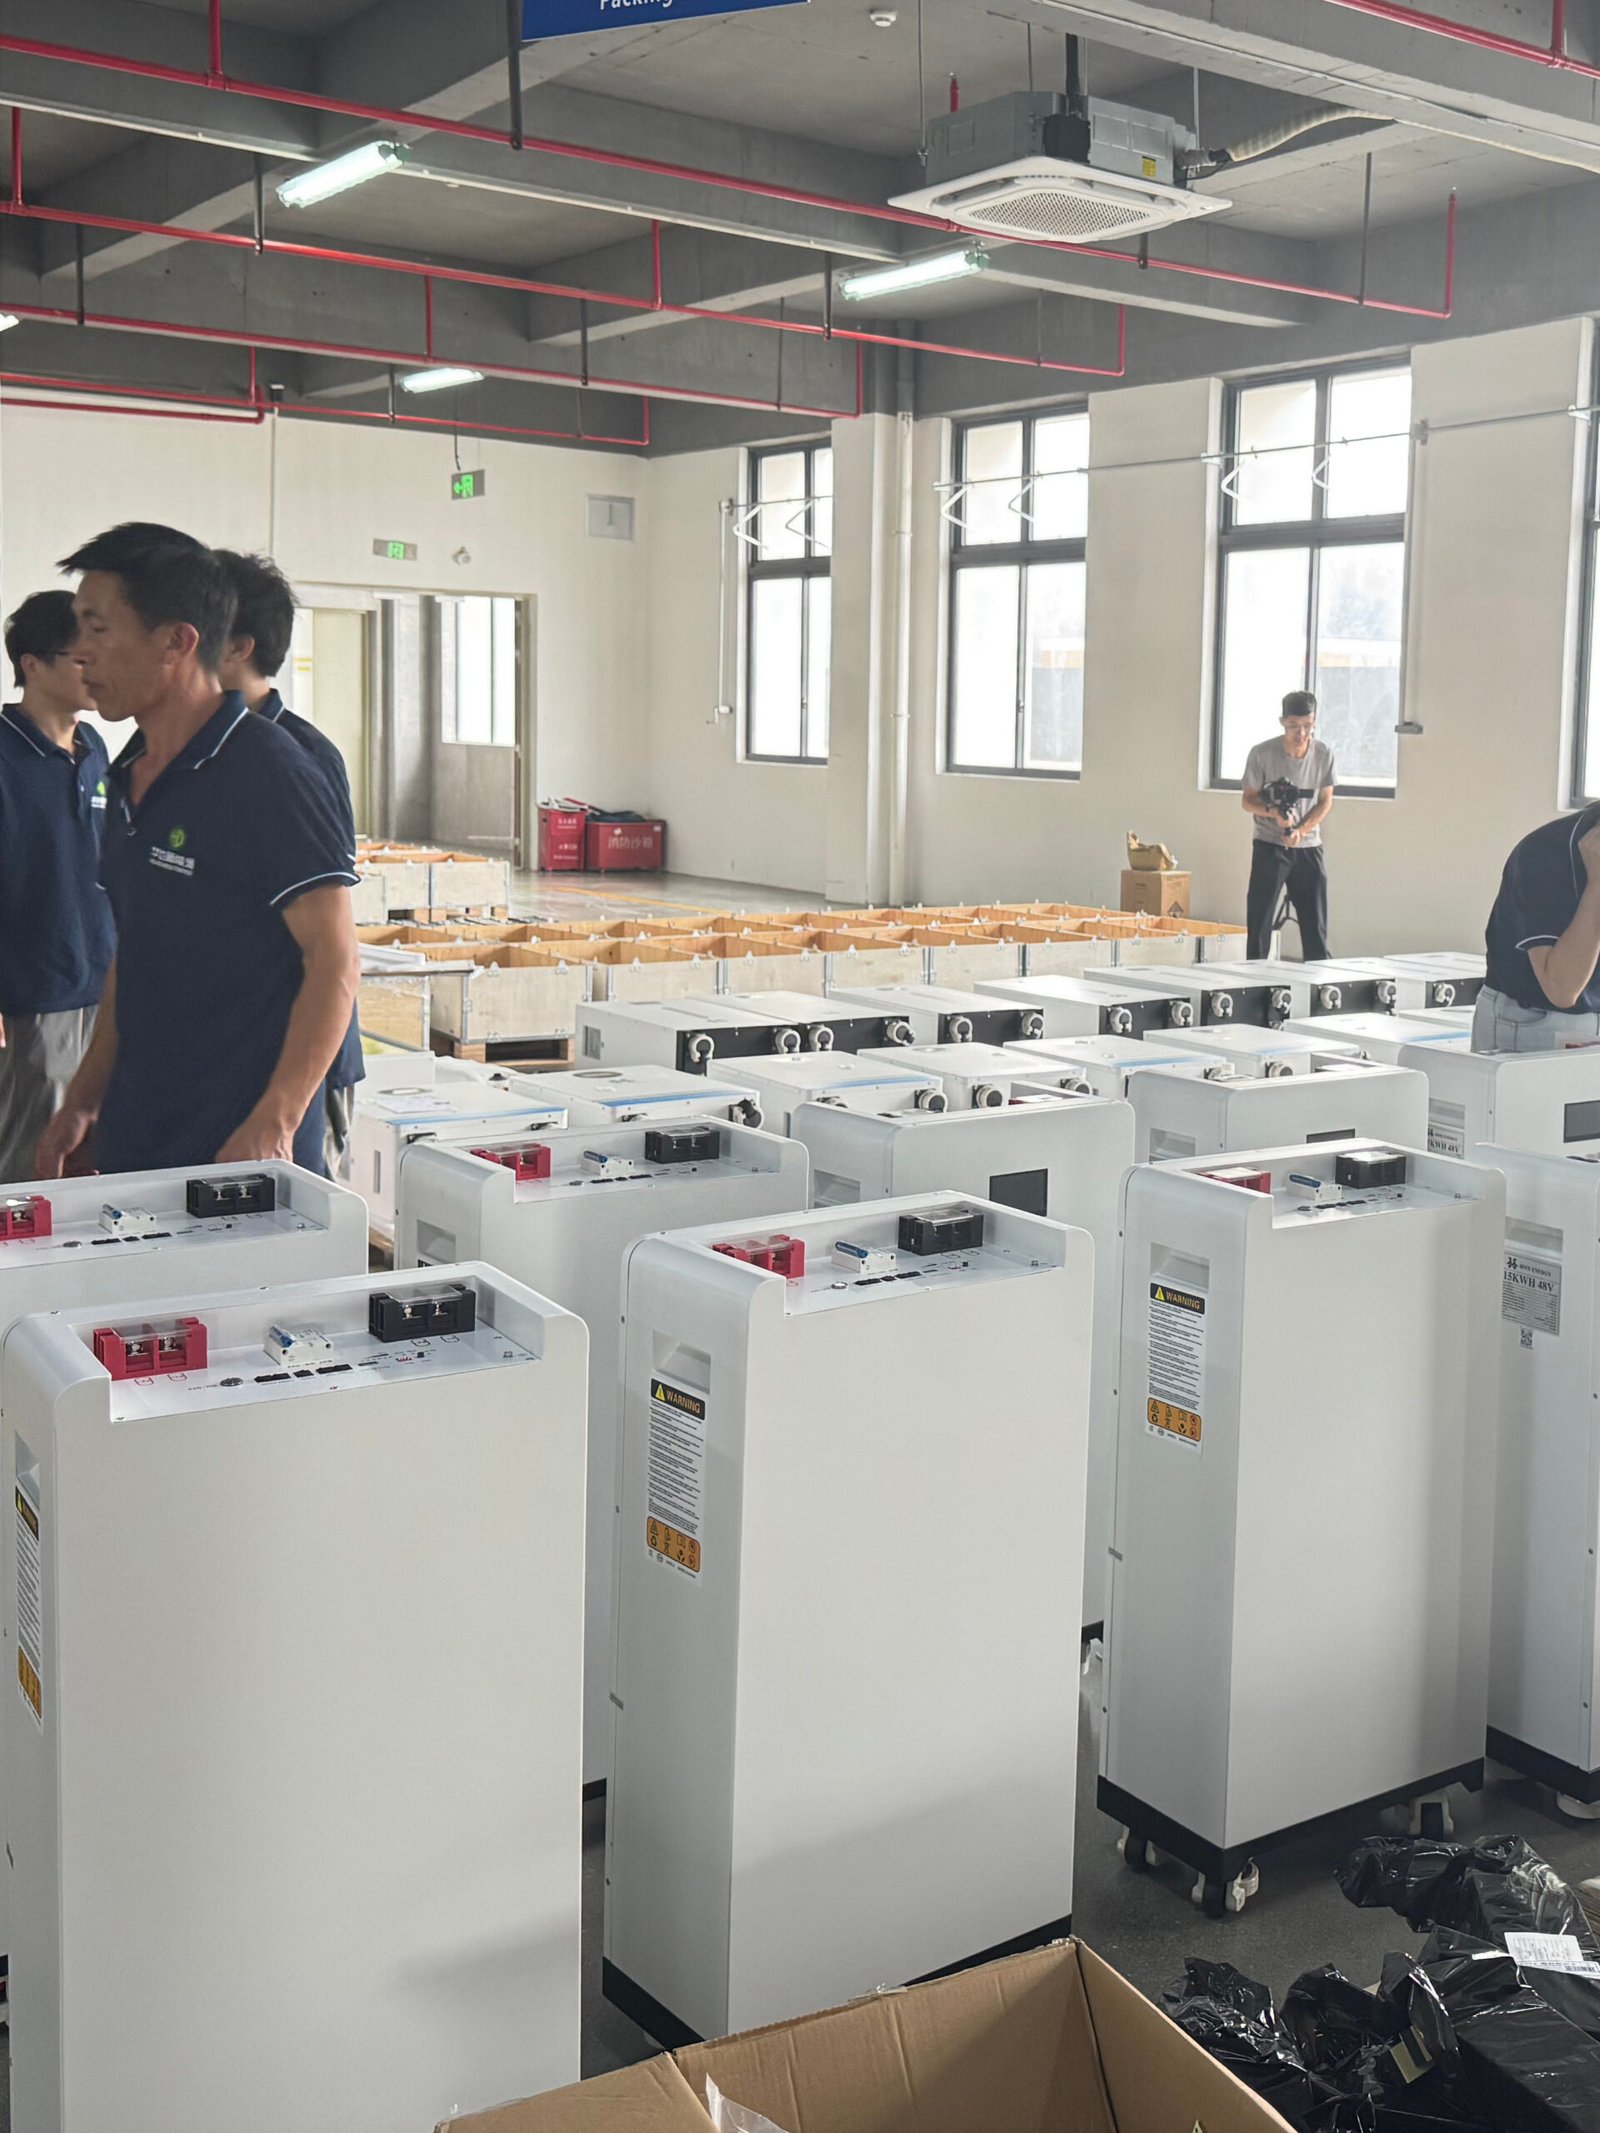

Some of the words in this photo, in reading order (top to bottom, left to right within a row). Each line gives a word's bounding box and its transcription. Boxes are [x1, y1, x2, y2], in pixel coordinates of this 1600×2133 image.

[600, 0, 673, 10] Pacg
[1504, 1271, 1535, 1287] 15KWH
[1537, 1280, 1554, 1292] 48V
[1166, 1291, 1200, 1310] WARNING
[666, 1389, 701, 1414] WARNING
